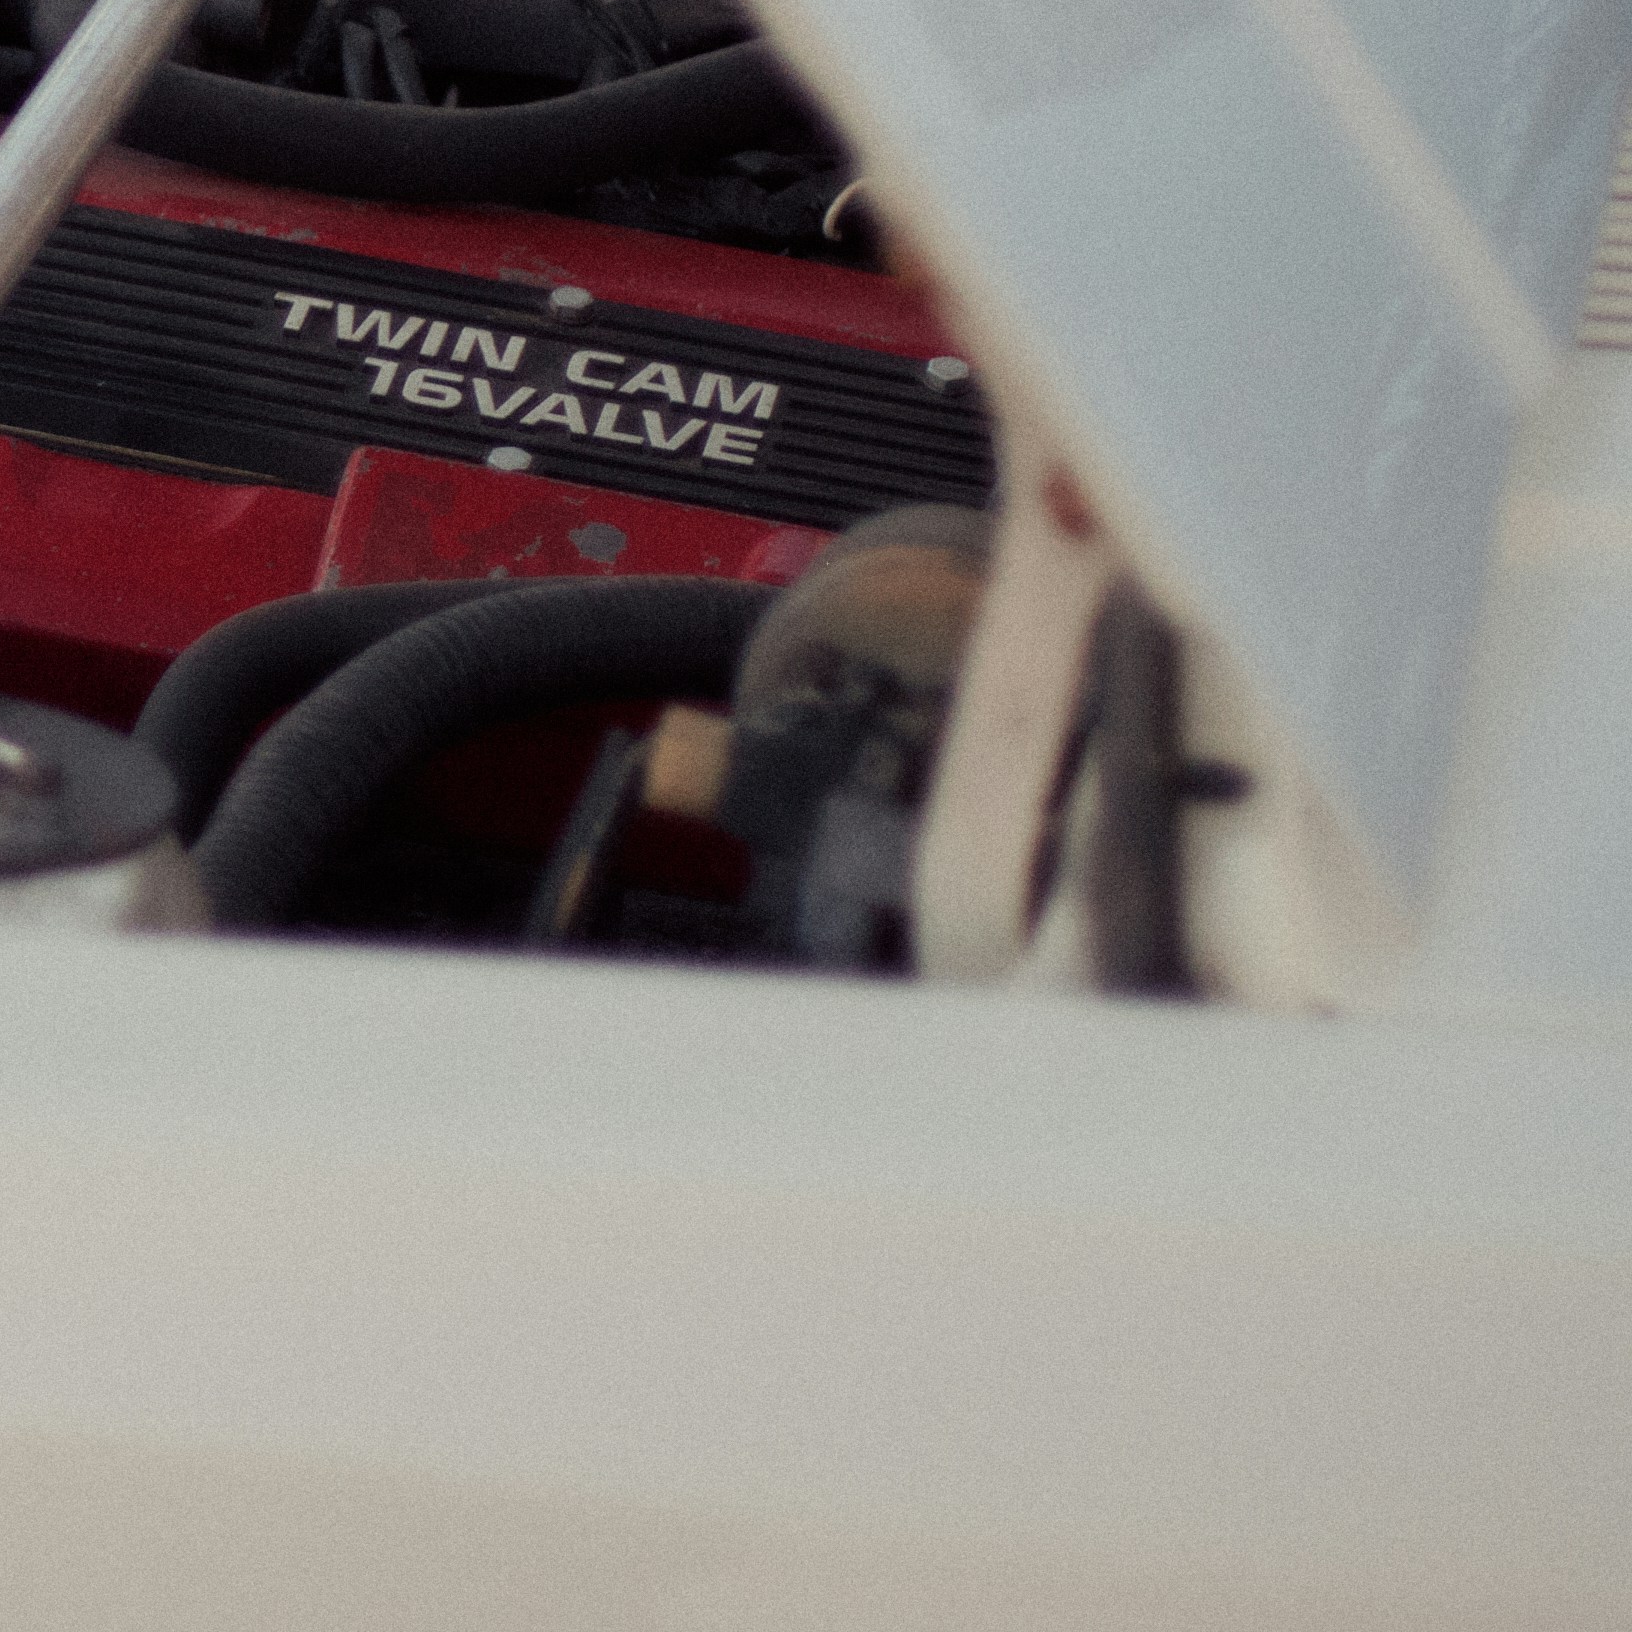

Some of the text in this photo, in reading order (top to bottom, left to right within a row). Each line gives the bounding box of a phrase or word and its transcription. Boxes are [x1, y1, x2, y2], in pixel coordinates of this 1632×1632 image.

[272, 290, 779, 421] TWIN CAM
[362, 356, 766, 467] 16VALVE
